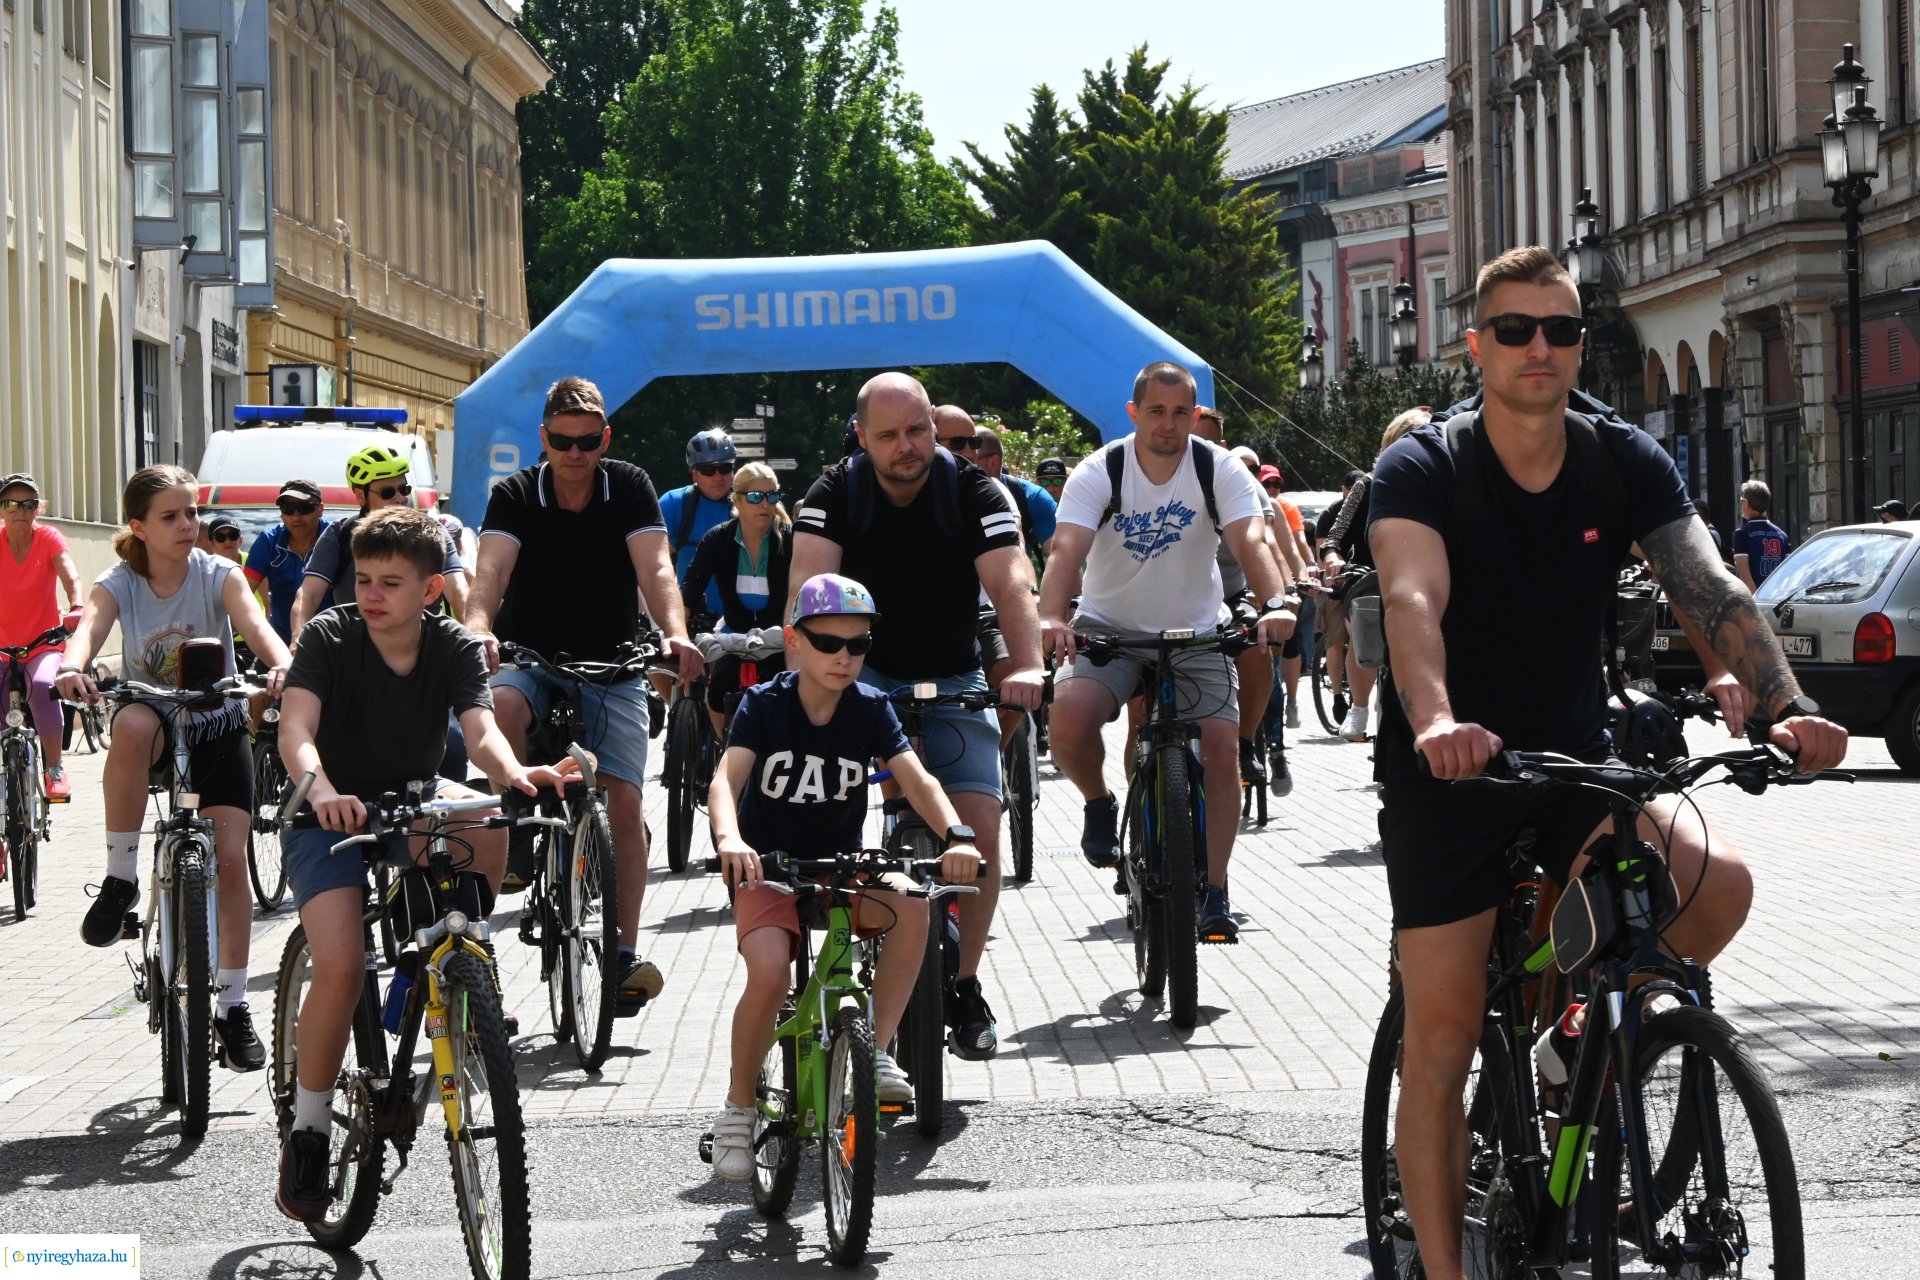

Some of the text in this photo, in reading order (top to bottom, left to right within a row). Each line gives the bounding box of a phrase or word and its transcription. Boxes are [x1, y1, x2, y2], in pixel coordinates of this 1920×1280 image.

[695, 285, 957, 331] SHIMANO
[1113, 510, 1152, 535] Enjoy
[1762, 538, 1781, 556] 19
[760, 750, 863, 804] GAP
